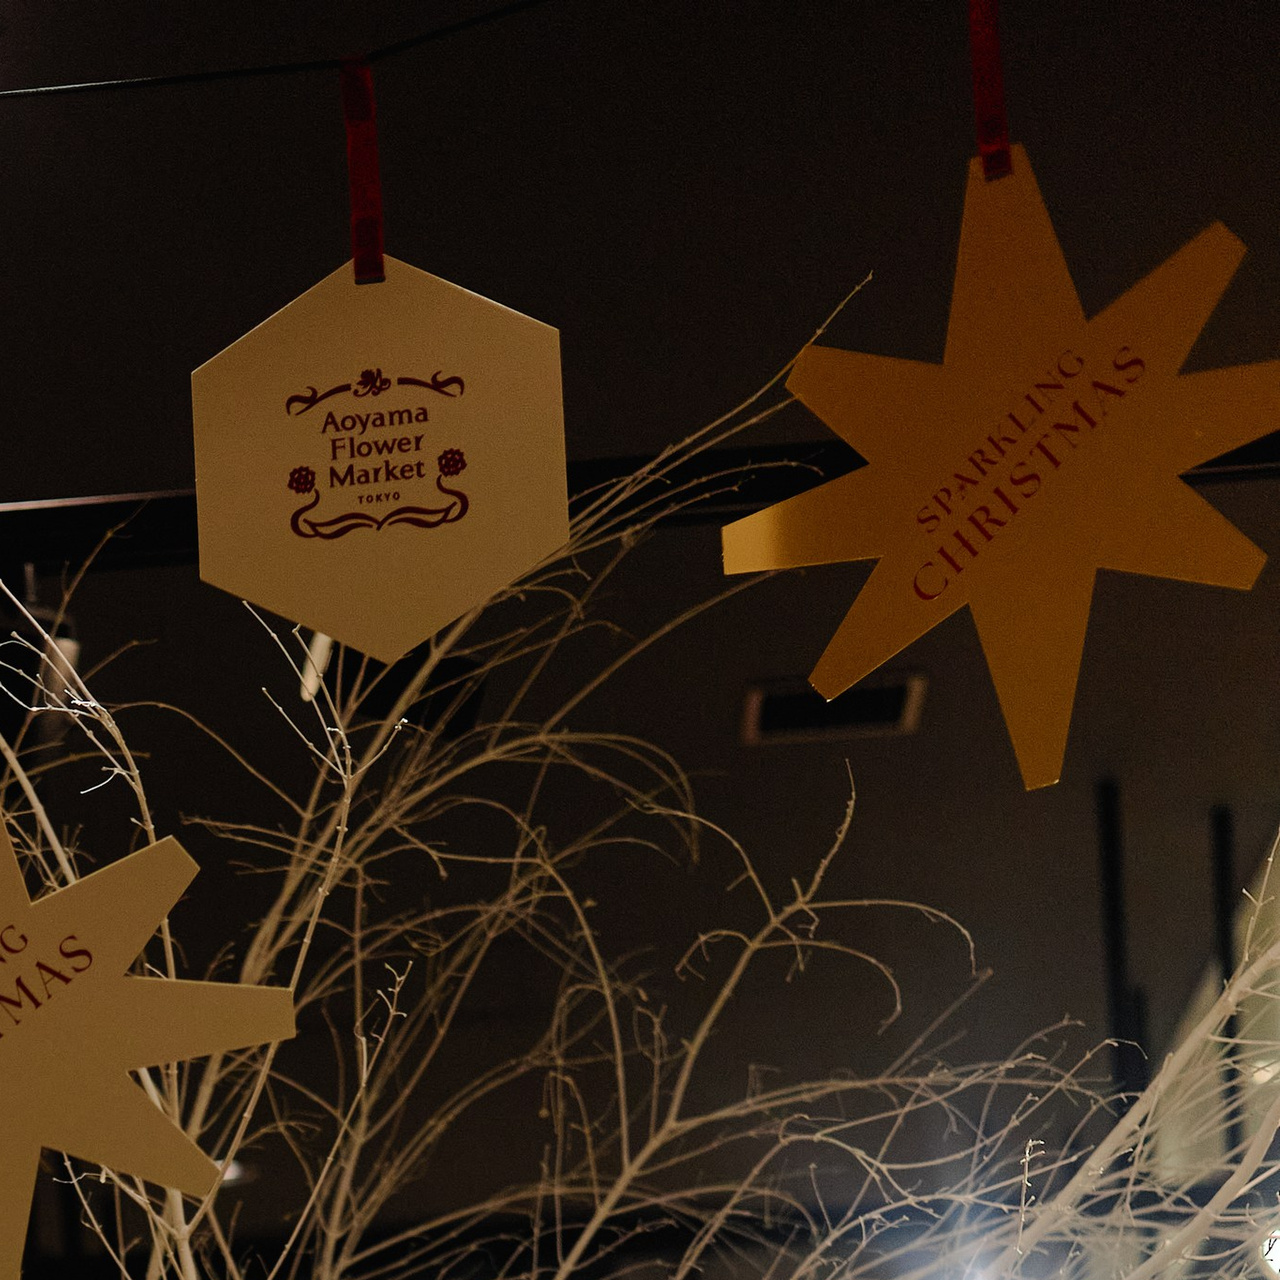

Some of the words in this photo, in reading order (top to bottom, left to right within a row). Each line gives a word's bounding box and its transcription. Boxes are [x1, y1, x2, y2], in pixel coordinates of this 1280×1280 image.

[321, 406, 430, 436] Aoyama
[330, 434, 425, 461] Flower
[916, 348, 1085, 534] SPARKLING
[329, 459, 426, 488] Market
[912, 344, 1147, 602] CHRISTMAS
[357, 491, 401, 505] TOKYO
